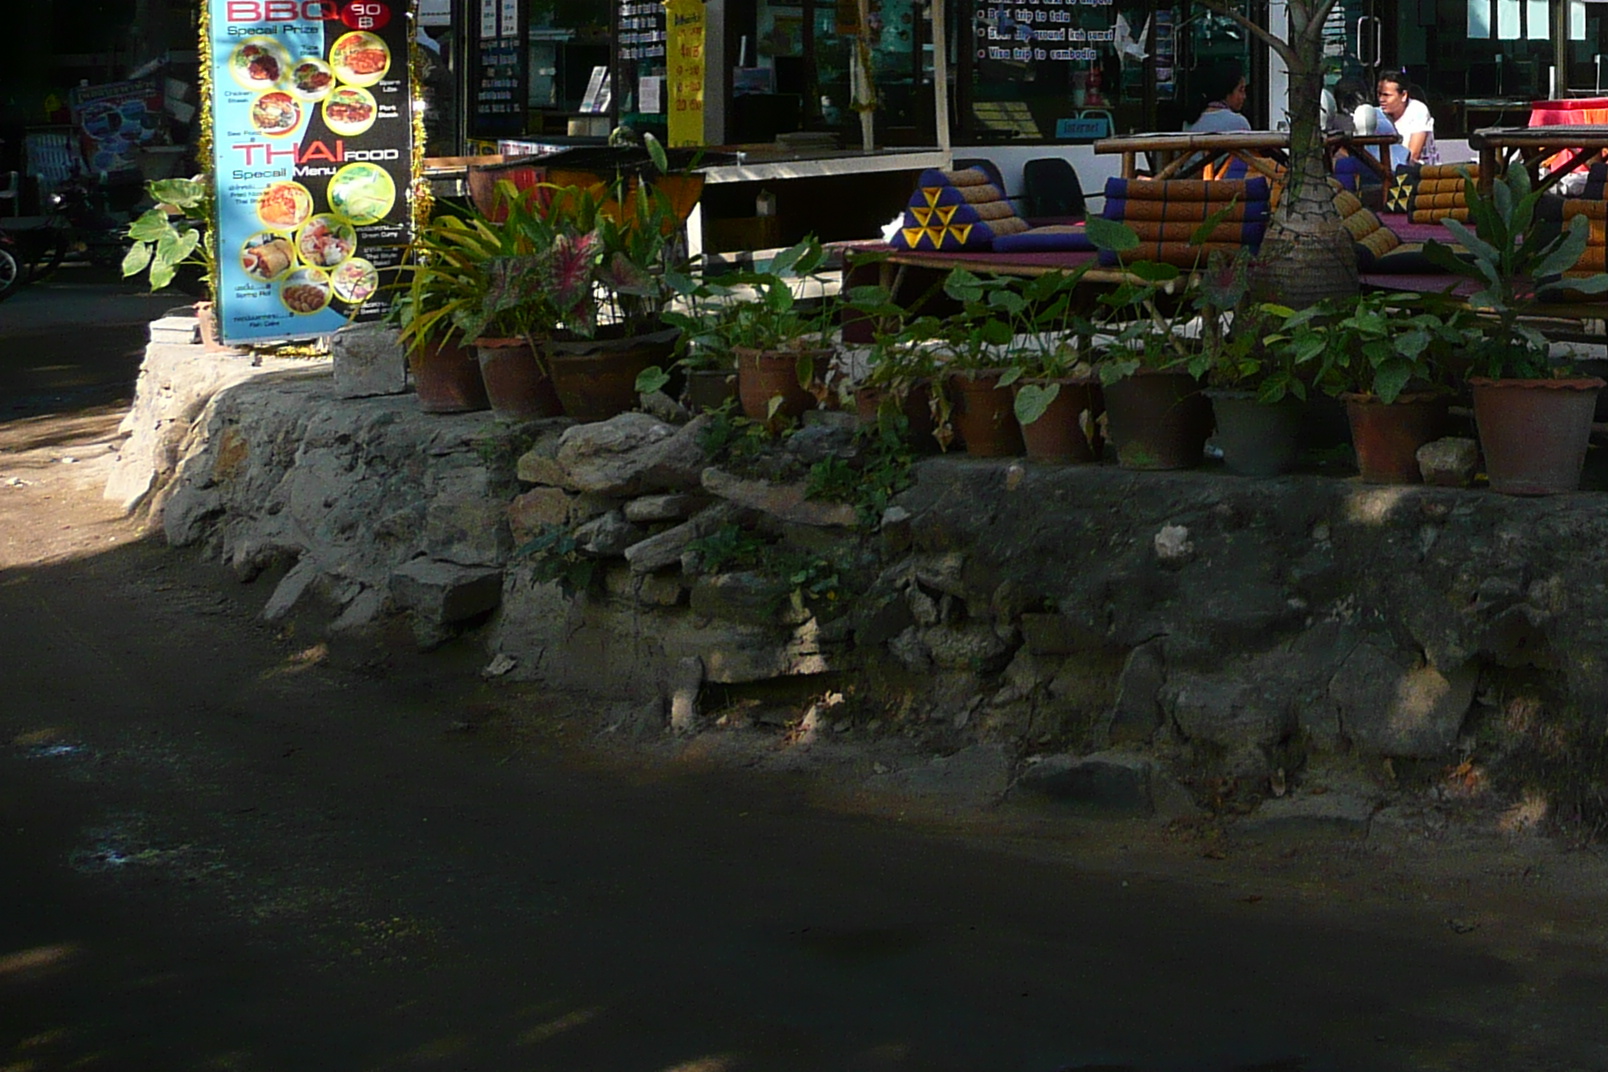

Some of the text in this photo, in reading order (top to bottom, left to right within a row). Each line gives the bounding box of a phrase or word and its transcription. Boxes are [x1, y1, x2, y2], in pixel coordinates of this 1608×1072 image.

[226, 0, 340, 23] BBQ
[350, 3, 381, 16] 90
[1015, 9, 1034, 23] trip
[1035, 10, 1047, 22] to
[283, 24, 319, 35] Prize
[988, 47, 1097, 62] Visa trip to cambodia
[232, 140, 399, 166] THAI FOOD
[293, 165, 337, 177] Menu
